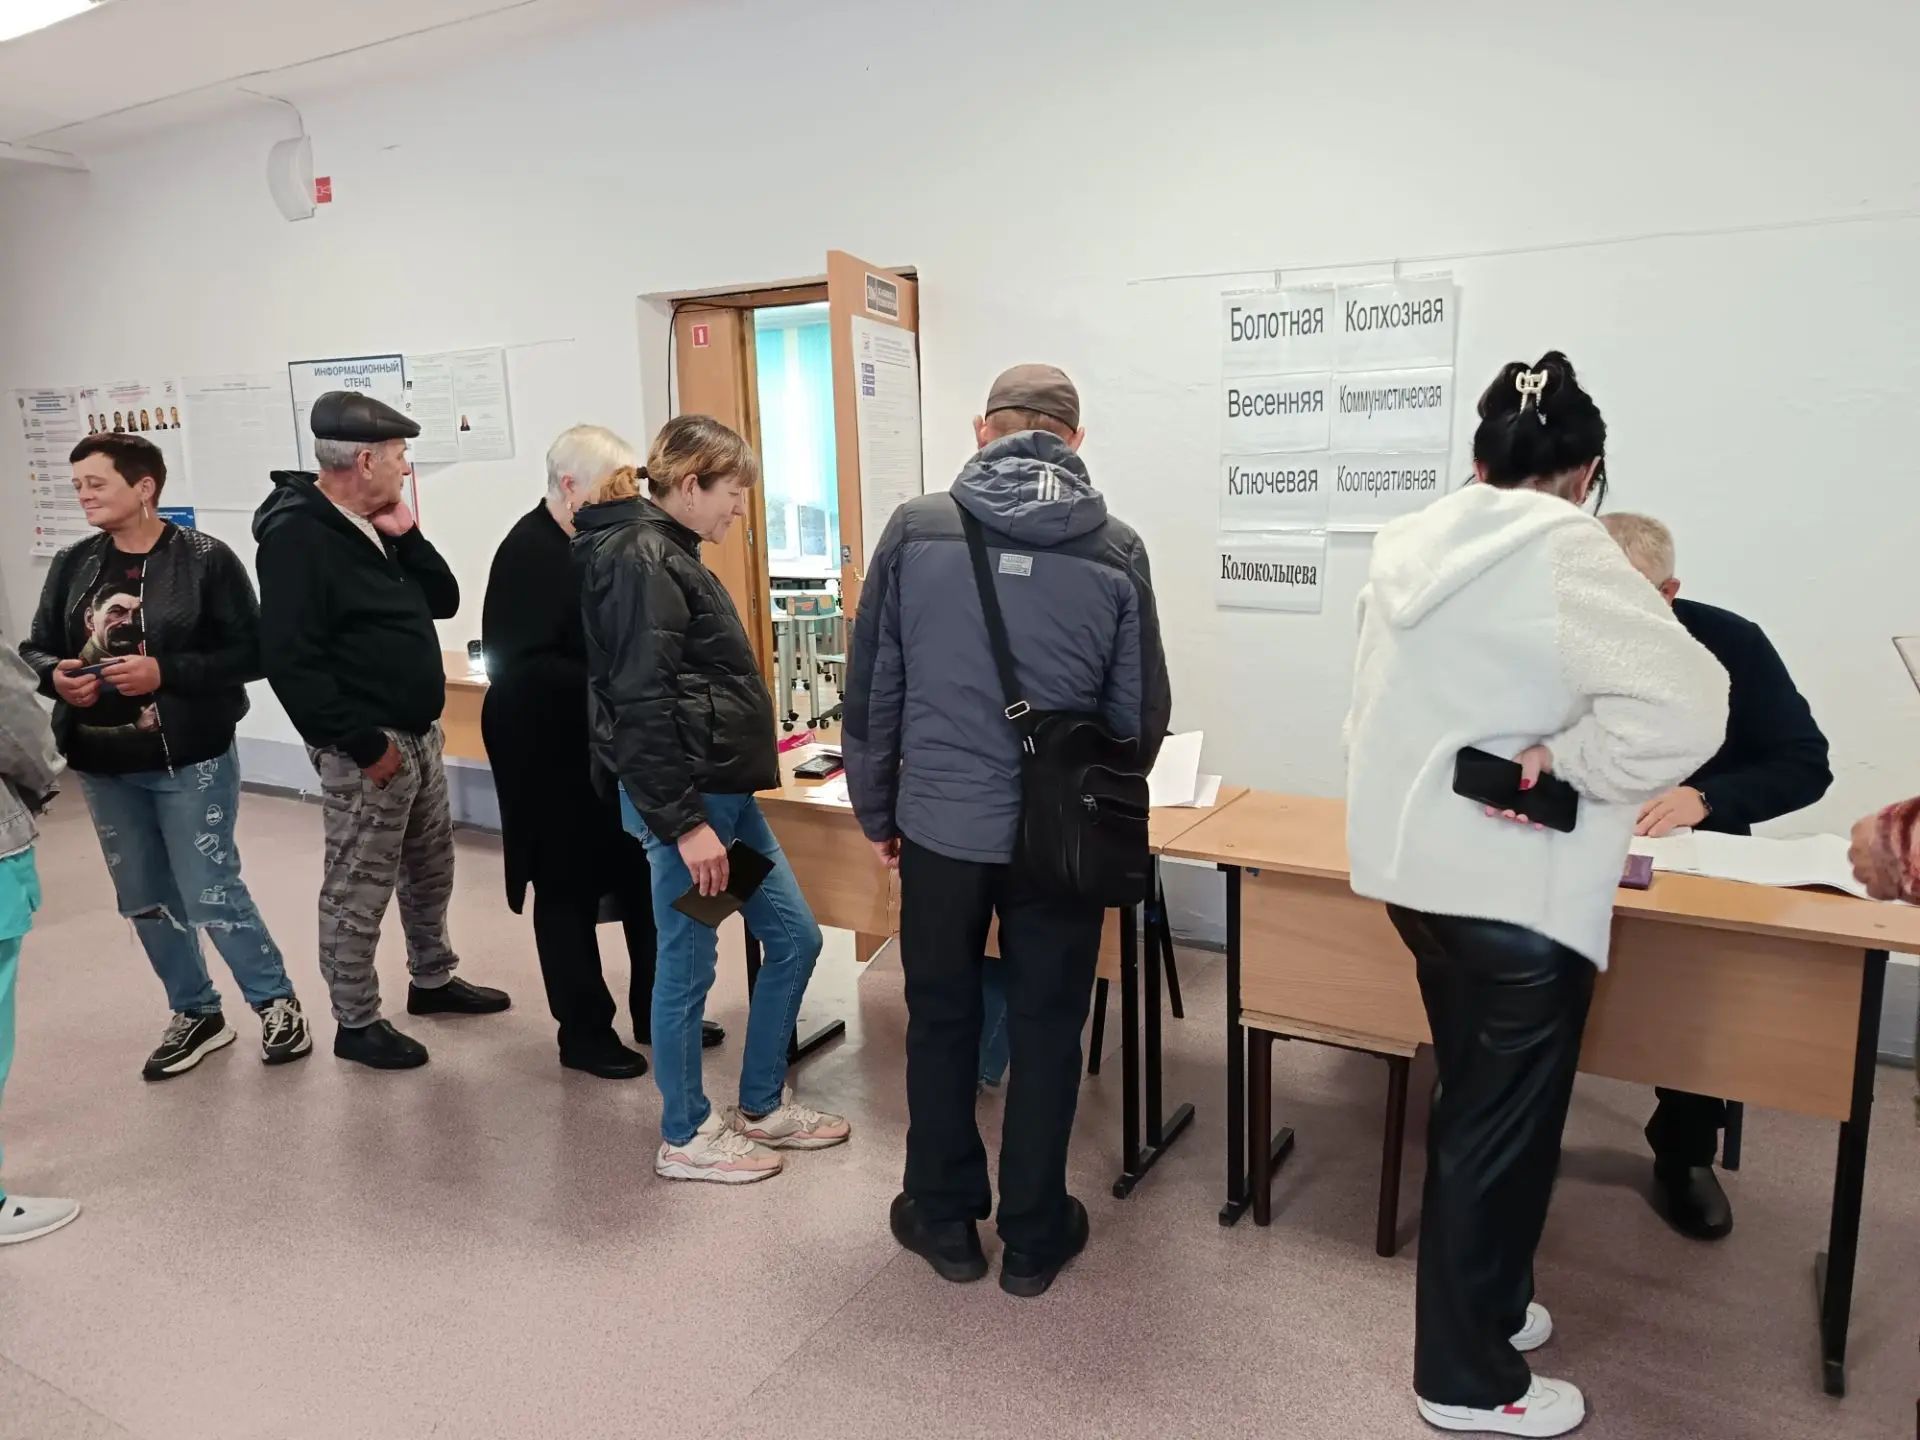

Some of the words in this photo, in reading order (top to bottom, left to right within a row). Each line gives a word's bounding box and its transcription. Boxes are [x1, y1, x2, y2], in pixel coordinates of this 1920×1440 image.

[1230, 307, 1324, 342] Болотная
[1345, 298, 1443, 332] Колхозная
[314, 360, 400, 376] ИНФОРМАЦИОННЫЙ
[344, 377, 371, 388] СТЕНД
[1228, 389, 1324, 418] Весенняя
[1339, 384, 1442, 419] Коммунистическая
[1228, 466, 1318, 496] Ключевая
[1337, 465, 1436, 498] Кооперативная
[1220, 553, 1317, 587] Колокольцева
